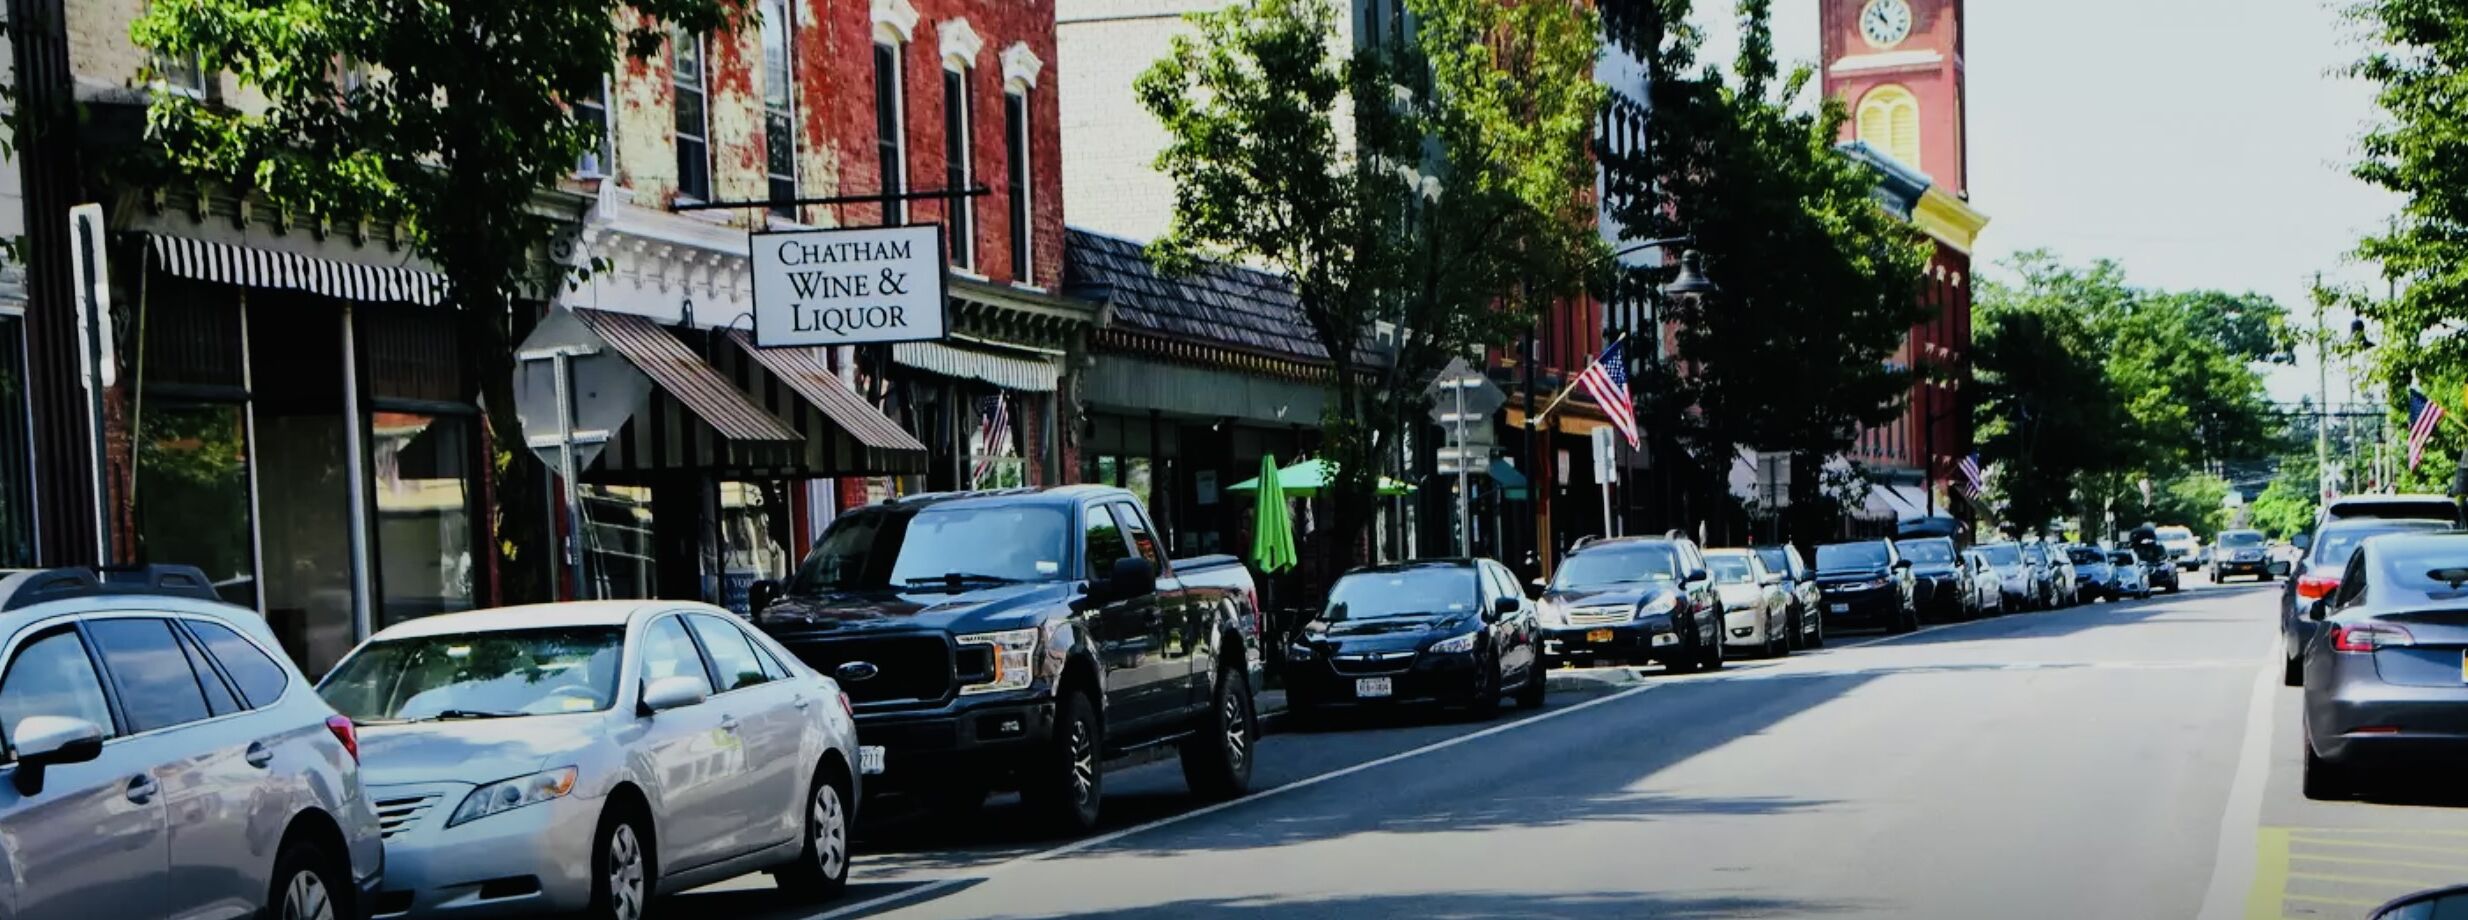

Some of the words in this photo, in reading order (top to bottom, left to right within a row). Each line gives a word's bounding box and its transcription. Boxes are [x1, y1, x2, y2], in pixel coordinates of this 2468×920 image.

[778, 240, 912, 266] CHATHAM
[786, 271, 870, 299] WINE
[878, 267, 909, 296] &
[791, 304, 908, 336] LIQUOR
